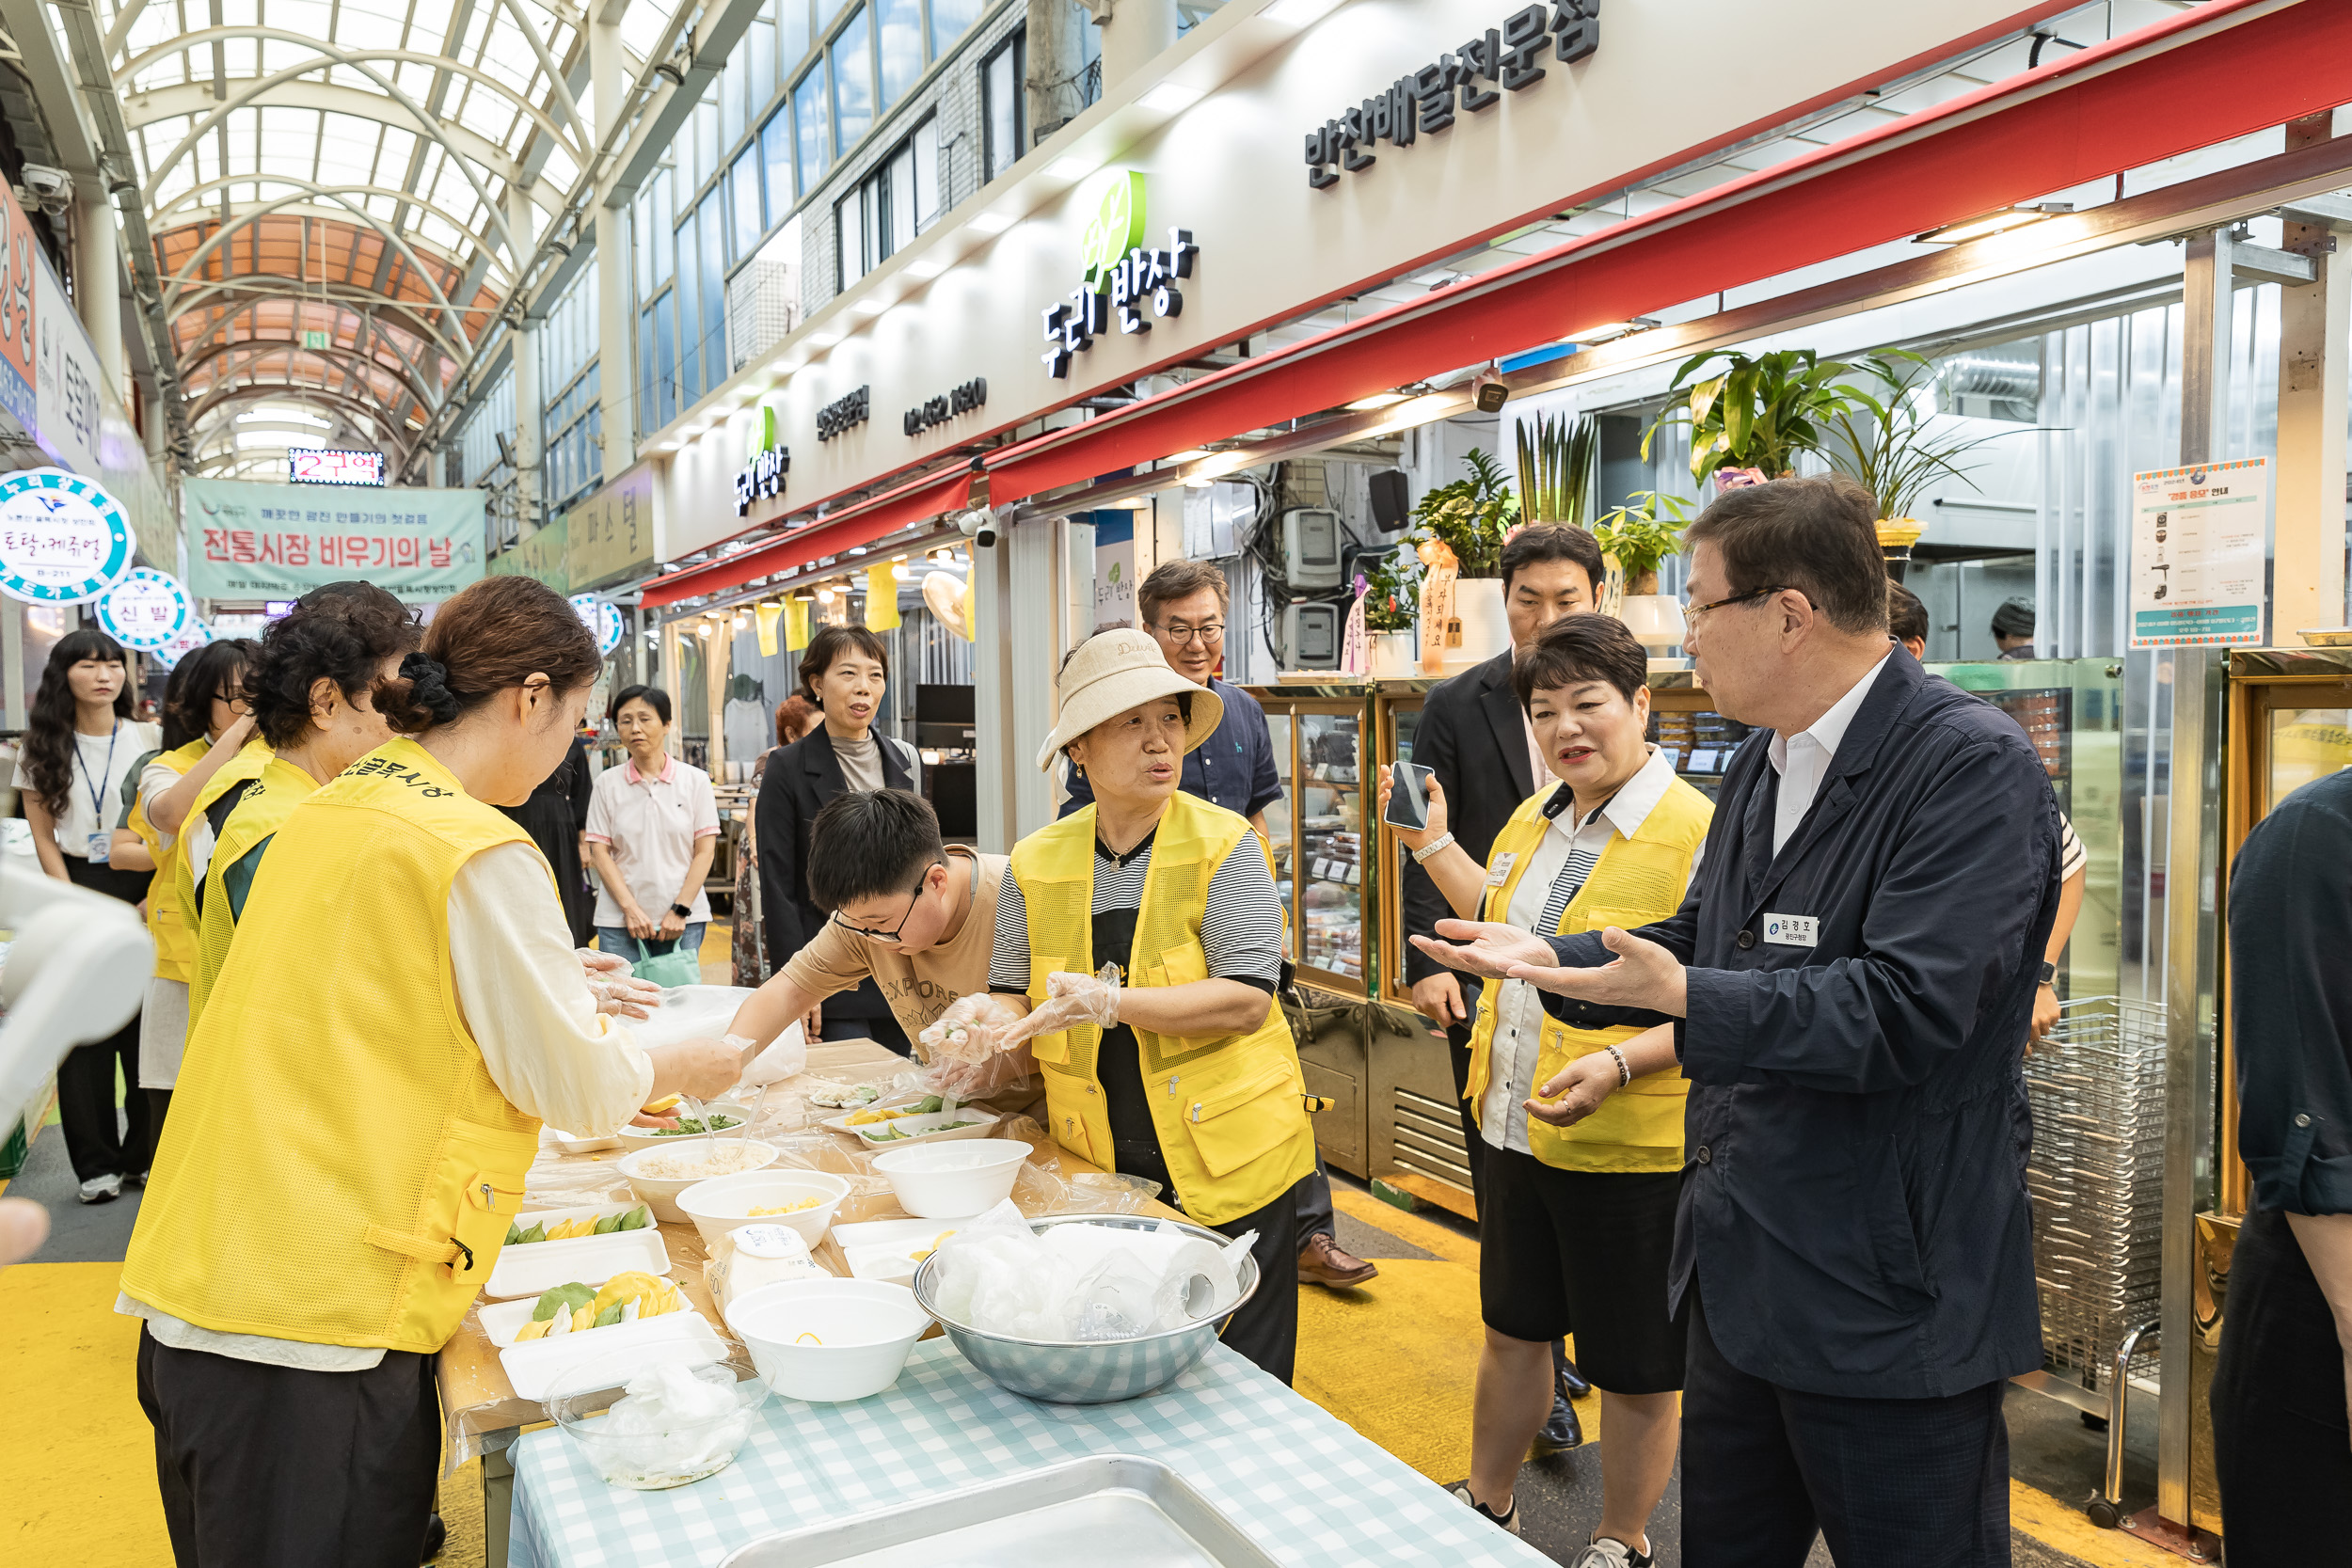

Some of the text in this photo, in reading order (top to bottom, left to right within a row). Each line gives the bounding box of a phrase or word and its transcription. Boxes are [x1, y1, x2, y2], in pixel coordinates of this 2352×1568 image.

[1305, 0, 1599, 189] 반찬배달전문점
[298, 452, 374, 478] 2구역
[0, 475, 44, 505] 누리
[2211, 487, 2229, 496] 안내
[203, 529, 453, 568] 전통시장 비우기의 날
[1432, 575, 1451, 646] 부자되세요
[336, 757, 454, 798] 산골목시장
[1785, 932, 1807, 942] 광진구청장
